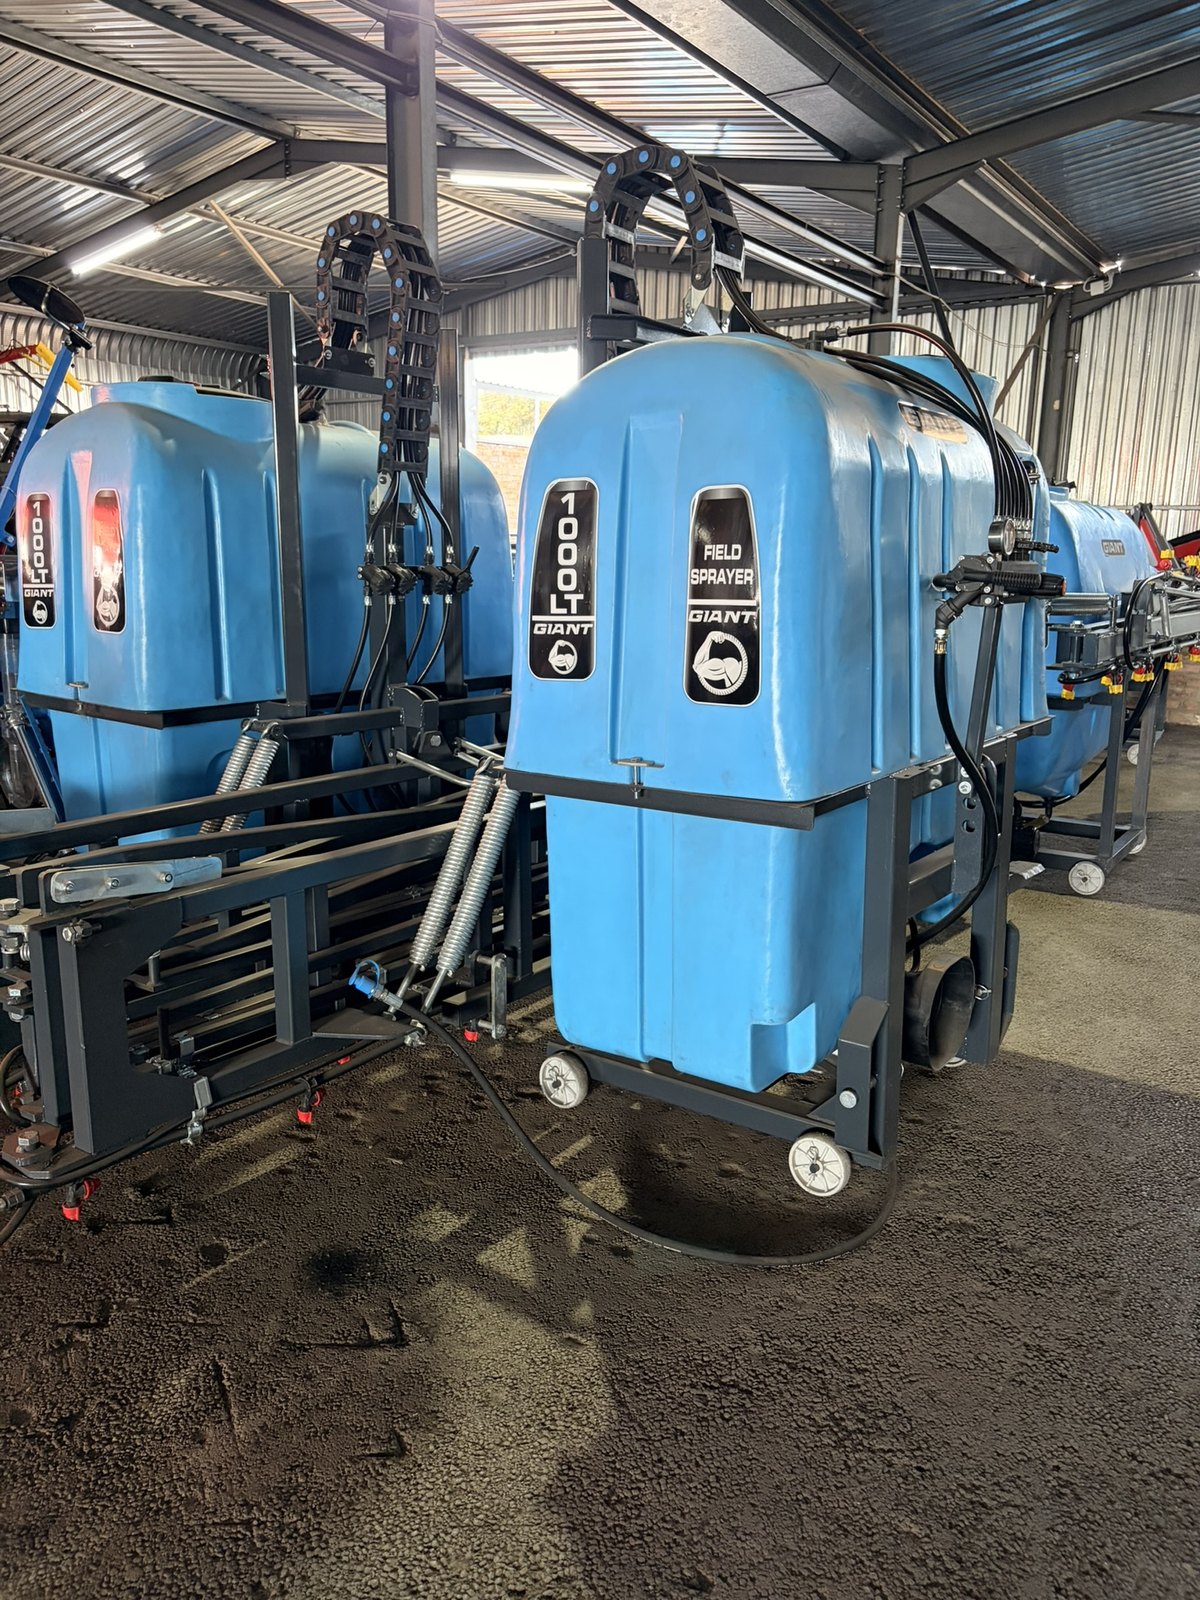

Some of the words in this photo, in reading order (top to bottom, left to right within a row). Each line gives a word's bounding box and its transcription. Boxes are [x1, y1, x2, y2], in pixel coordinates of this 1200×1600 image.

[32, 501, 45, 568] 1000
[557, 492, 579, 591] 1000
[703, 544, 742, 561] FIELD
[1103, 541, 1123, 554] GIANT
[30, 569, 49, 583] LT
[690, 568, 754, 585] SPRAYER
[24, 589, 54, 598] GIANT
[550, 593, 584, 614] LT
[688, 609, 757, 624] GIANT
[532, 623, 594, 635] GIANT
